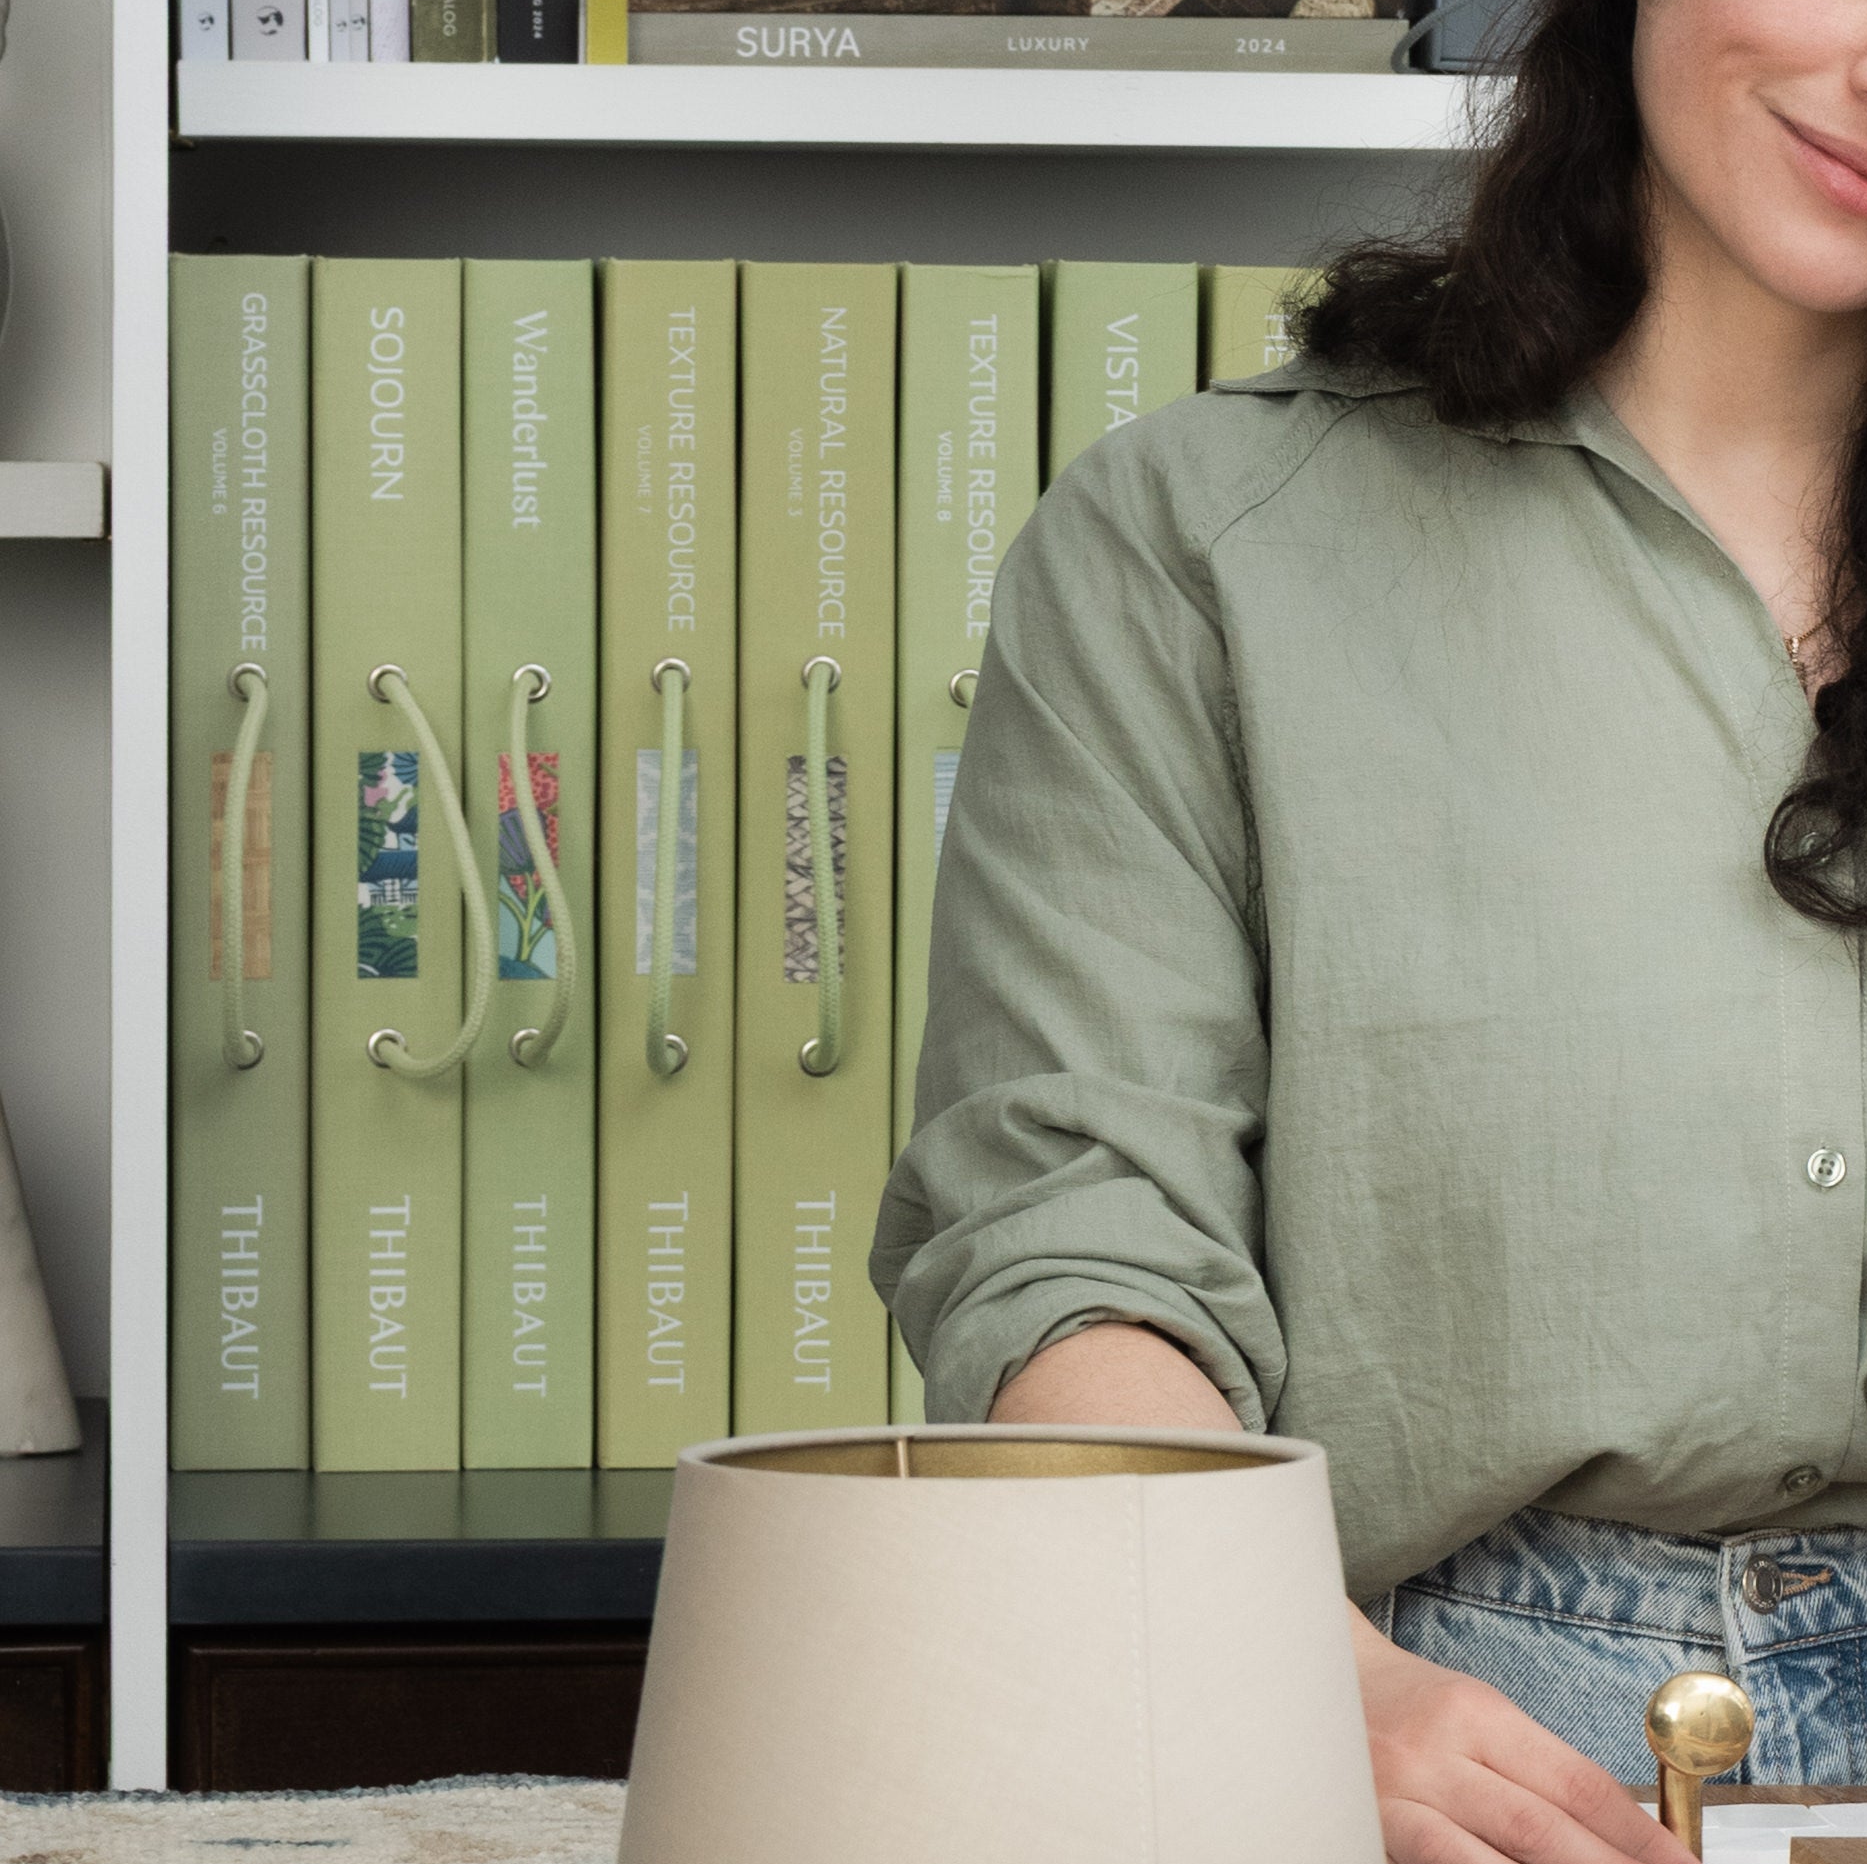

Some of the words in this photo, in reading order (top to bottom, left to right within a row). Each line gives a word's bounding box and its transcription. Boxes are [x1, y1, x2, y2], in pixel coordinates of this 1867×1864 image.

[532, 10, 543, 40] 2024
[736, 26, 861, 59] SURYA
[1007, 36, 1090, 53] LUXURY
[1235, 37, 1286, 54] 2024
[241, 292, 268, 488] GRASSCLOTH
[366, 306, 405, 500] SOJOURN
[511, 309, 549, 528] Wanderlust
[667, 306, 696, 450] TEXTURE
[819, 307, 848, 460] NATURAL
[968, 313, 998, 459] TEXTURE
[211, 427, 229, 499] VOLUME
[211, 503, 228, 515] 6
[636, 424, 653, 498] VOLUME
[787, 427, 804, 501] VOLUME
[936, 430, 954, 505] VOLUME
[936, 509, 953, 523] 8
[240, 497, 268, 651] RESOURCE
[667, 461, 696, 632] RESOURCE
[817, 470, 847, 639] RESOURCE
[965, 468, 997, 640] RESOURCE
[220, 1194, 263, 1400] THIBAUT
[369, 1194, 411, 1399] THIBAUT
[512, 1194, 547, 1398] THIBAUT
[647, 1191, 689, 1394] THIBAUT
[793, 1190, 836, 1393] THIBAUT
